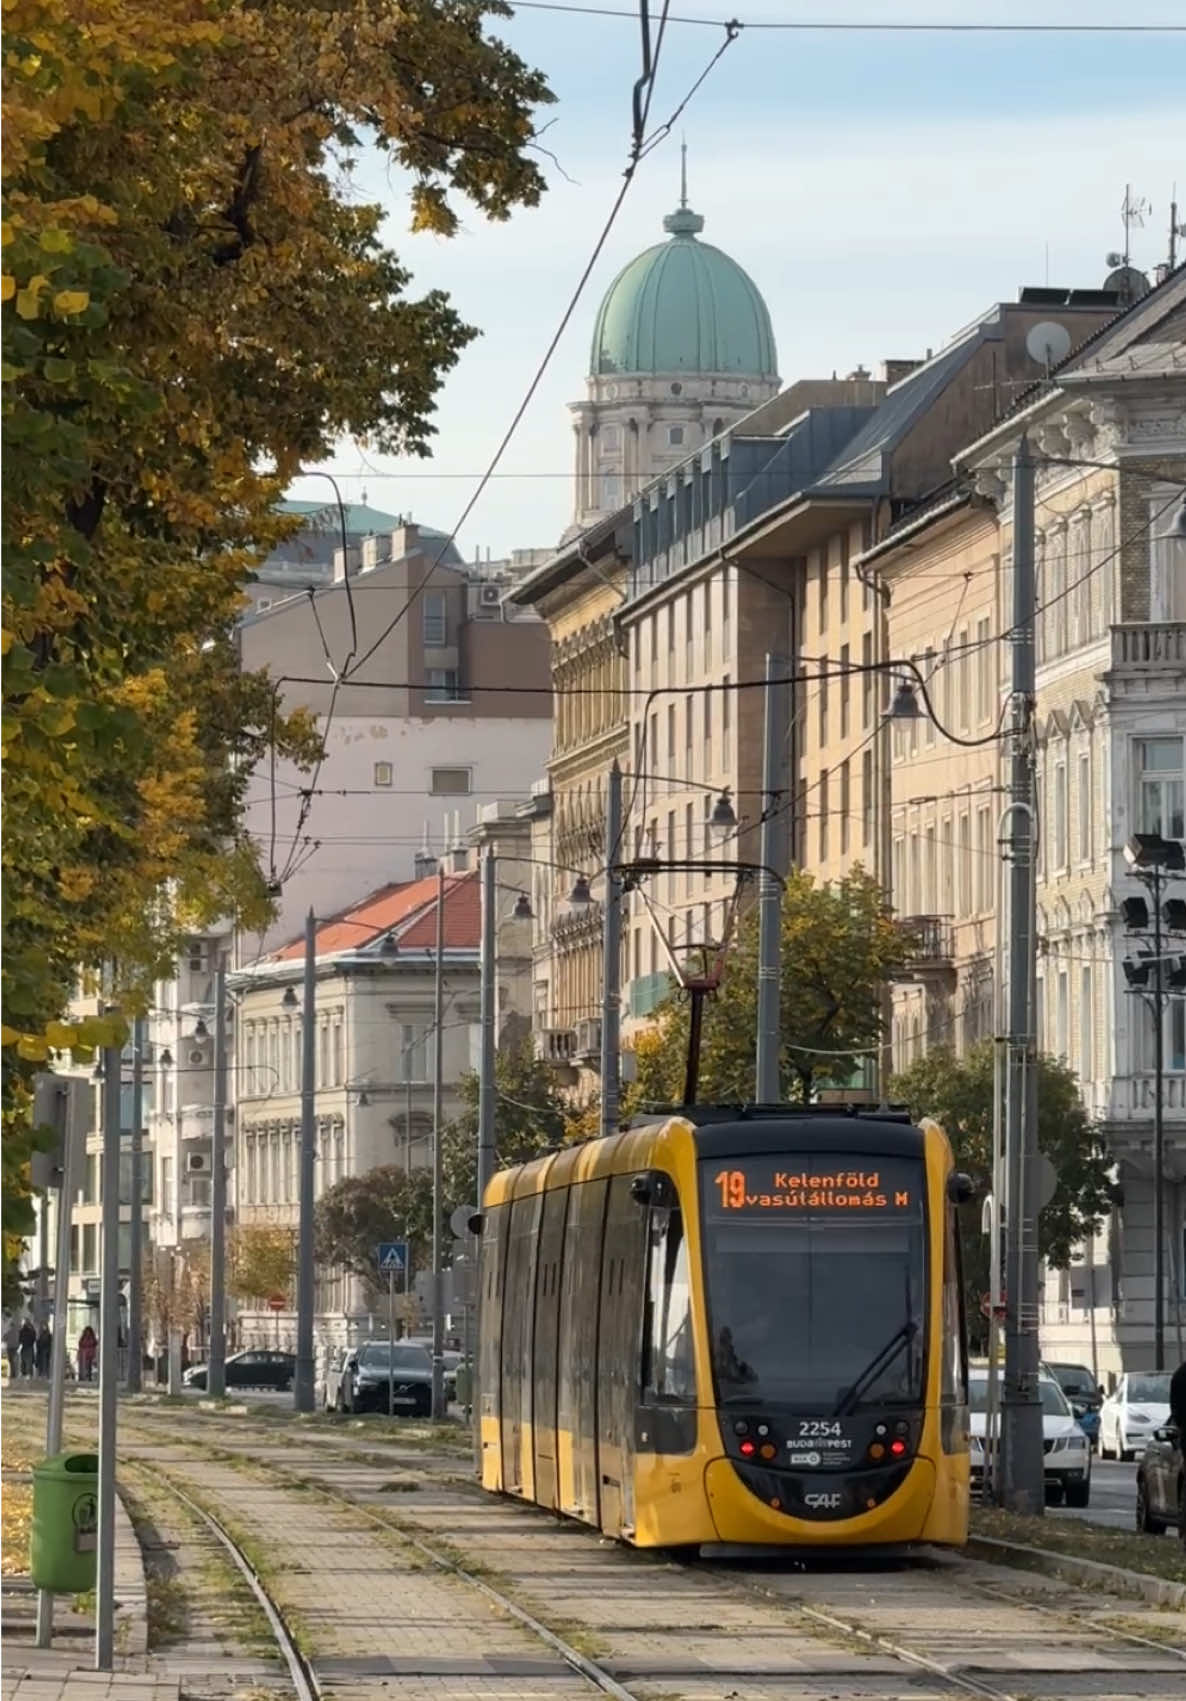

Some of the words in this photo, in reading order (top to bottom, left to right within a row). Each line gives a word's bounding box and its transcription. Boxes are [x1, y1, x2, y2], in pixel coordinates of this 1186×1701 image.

[774, 1172, 880, 1188] Kelenföld
[714, 1171, 746, 1208] 19
[746, 1191, 887, 1207] vasútállomás
[895, 1191, 909, 1207] M
[799, 1421, 841, 1437] 2254
